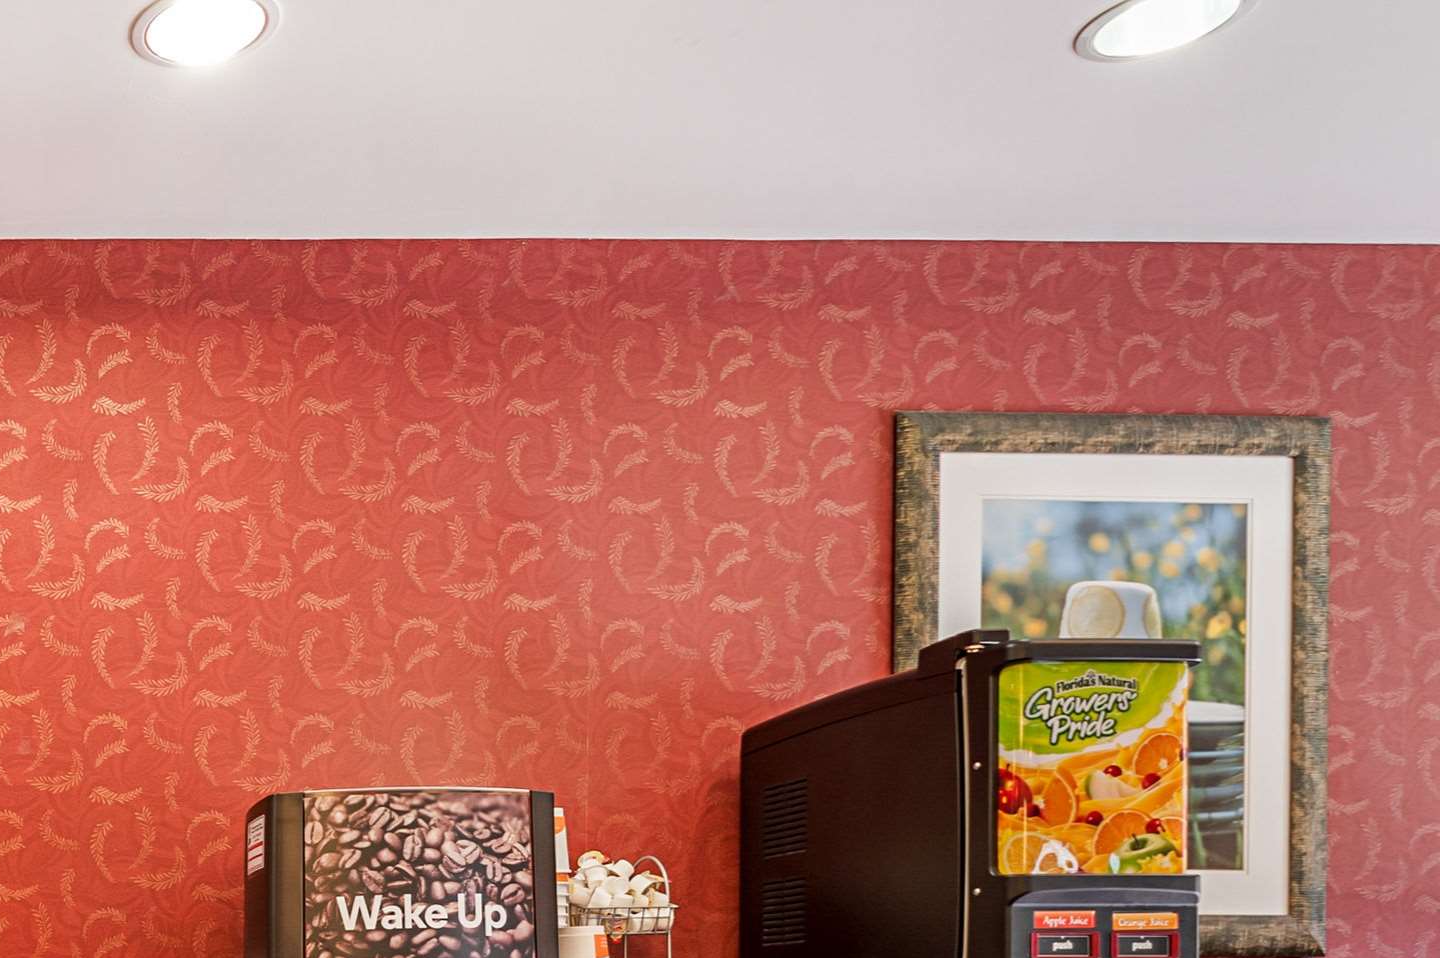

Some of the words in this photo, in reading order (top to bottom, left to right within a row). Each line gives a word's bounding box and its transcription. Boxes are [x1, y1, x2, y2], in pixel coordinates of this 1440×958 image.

[1098, 674, 1137, 690] Natural
[1046, 710, 1117, 745] Pride
[335, 893, 449, 931] Wake
[457, 893, 508, 937] Up
[1042, 916, 1066, 927] Apple
[1069, 916, 1089, 926] Juice
[1118, 918, 1146, 929] Orange
[1149, 918, 1169, 927] Juice
[1052, 940, 1074, 952] push
[1131, 940, 1153, 952] push
